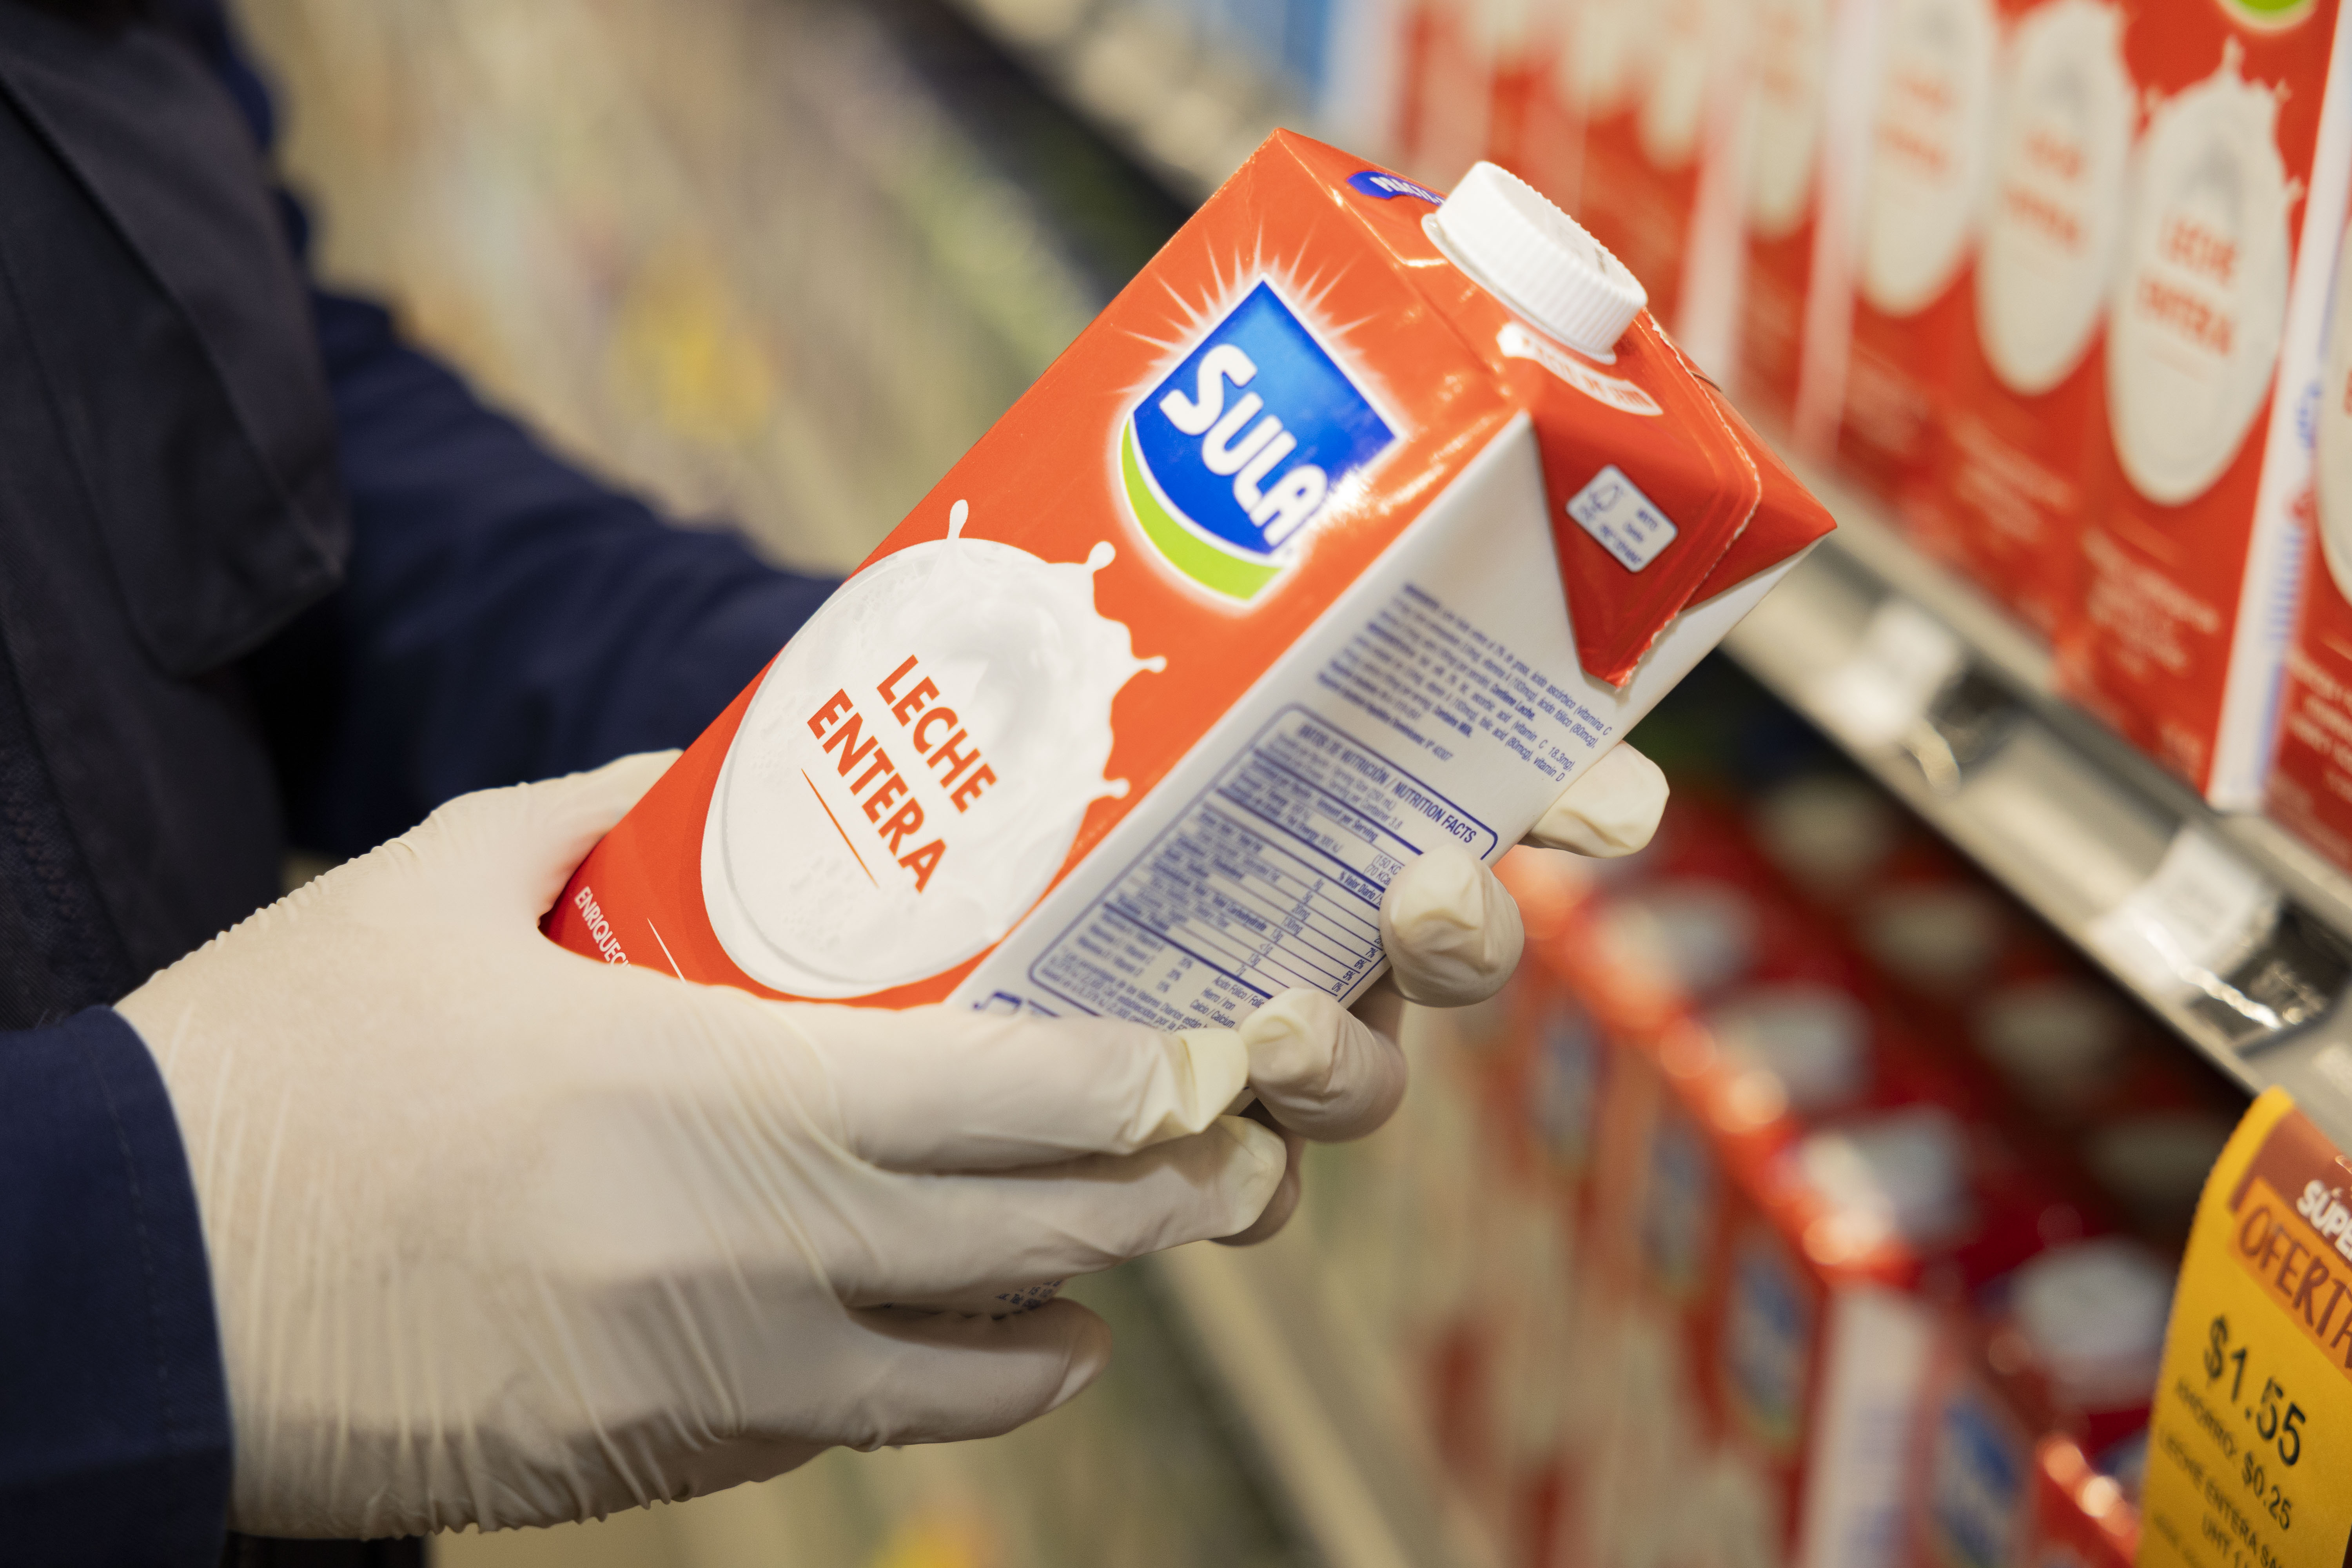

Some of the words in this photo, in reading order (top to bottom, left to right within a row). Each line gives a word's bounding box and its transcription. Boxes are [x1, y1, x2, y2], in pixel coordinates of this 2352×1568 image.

[1159, 343, 1328, 547] SULA
[1513, 700, 1539, 722] Leche.
[1544, 683, 1579, 710] ascórbico
[1572, 704, 1607, 732] (vitamina
[1601, 725, 1613, 736] C
[877, 654, 998, 813] LECHE
[1494, 708, 1513, 724] acid
[1509, 719, 1539, 744] (vitamin
[1537, 738, 1549, 749] C
[1544, 746, 1578, 772] 18.3mg),
[1552, 709, 1575, 728] fólico
[1567, 722, 1601, 750] (80mcg),
[1490, 726, 1509, 742] acid
[1503, 736, 1537, 762] (80mcg),
[1531, 755, 1559, 778] vitamin
[1554, 771, 1566, 782] D
[807, 689, 947, 894] ENTERA
[1389, 780, 1448, 824] NUTRITION
[1439, 814, 1479, 845] FACTS
[1387, 816, 1405, 831] 3.8
[1362, 863, 1380, 878] (70
[1370, 853, 1392, 871] (150
[1386, 862, 1403, 877] KC
[1342, 874, 1363, 891] Valor
[1356, 883, 1379, 900] Diario
[1288, 902, 1314, 922] 20mg
[574, 886, 632, 967] ENRIQUEC
[1364, 946, 1379, 959] 7%
[1352, 958, 1368, 971] 6%
[1341, 969, 1356, 982] 5%
[1227, 982, 1251, 1000] Fólico
[1243, 992, 1255, 1002] /
[1330, 981, 1345, 993] 0%
[1187, 997, 1212, 1016] Calcio
[1216, 995, 1227, 1005] /
[1220, 998, 1238, 1012] Iron
[1247, 994, 1267, 1009] Folic
[1205, 1008, 1216, 1018] /
[1209, 1009, 1238, 1030] Calcium
[2296, 1180, 2352, 1263] SÚPE
[2204, 1314, 2307, 1467] $1.55
[2241, 1450, 2292, 1531] $0.25
